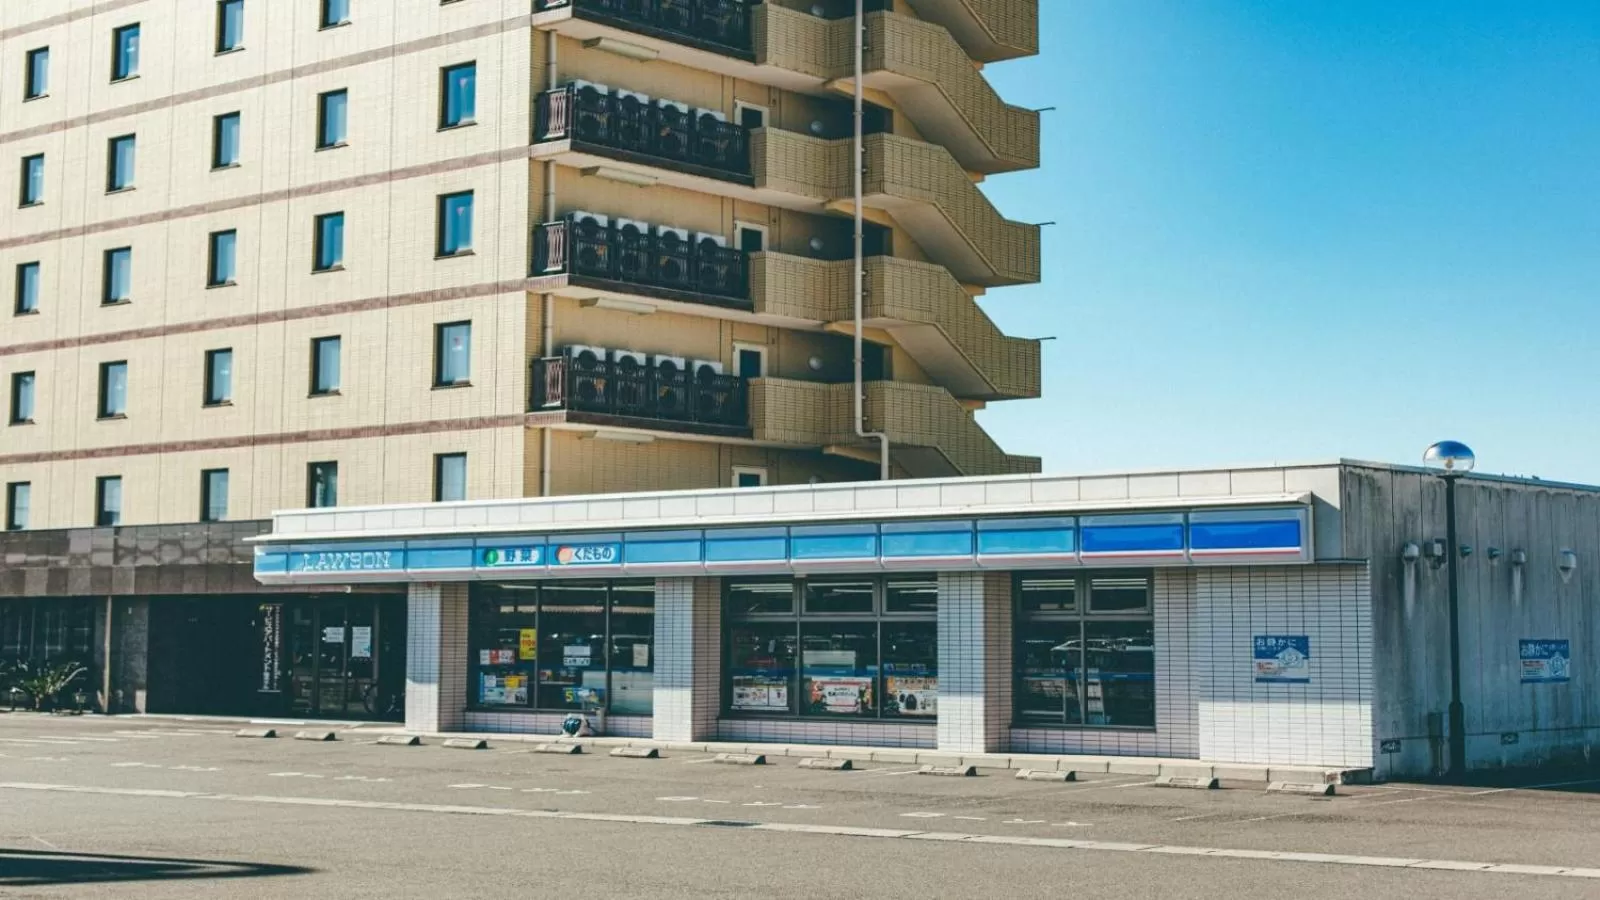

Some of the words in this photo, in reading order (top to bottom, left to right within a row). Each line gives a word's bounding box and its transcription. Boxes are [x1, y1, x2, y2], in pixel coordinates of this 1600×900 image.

[503, 548, 533, 562] 野菜
[574, 547, 612, 561] くだもの
[303, 551, 392, 572] LAWSON
